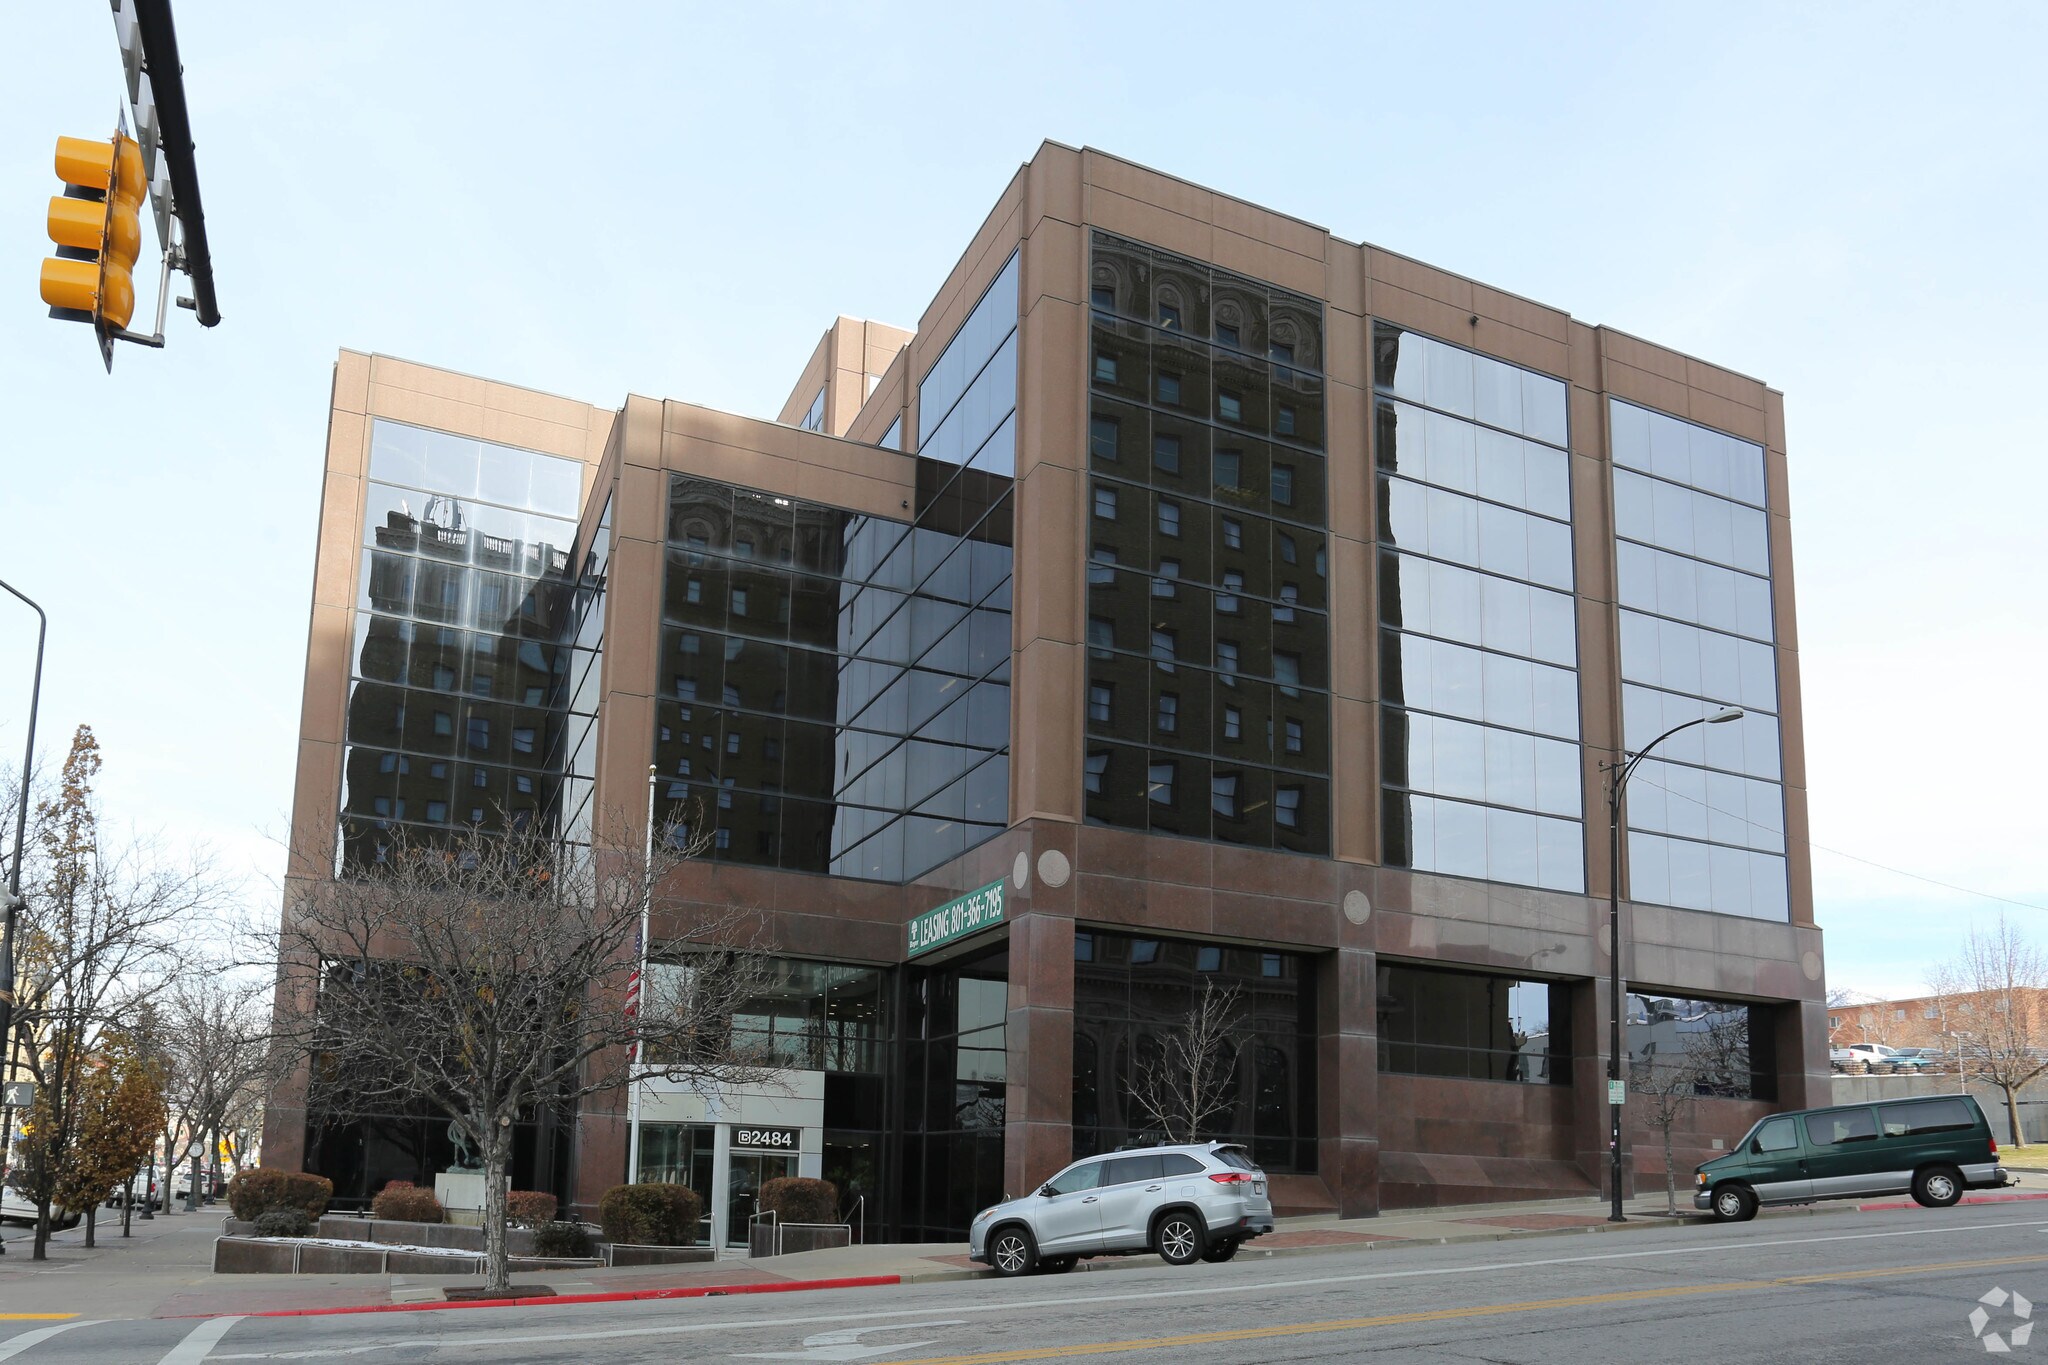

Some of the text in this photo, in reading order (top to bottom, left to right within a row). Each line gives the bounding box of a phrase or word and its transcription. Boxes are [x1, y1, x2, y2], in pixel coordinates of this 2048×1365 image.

[920, 885, 1002, 947] LEASING 801-366-7195
[751, 1130, 792, 1147] 2484
